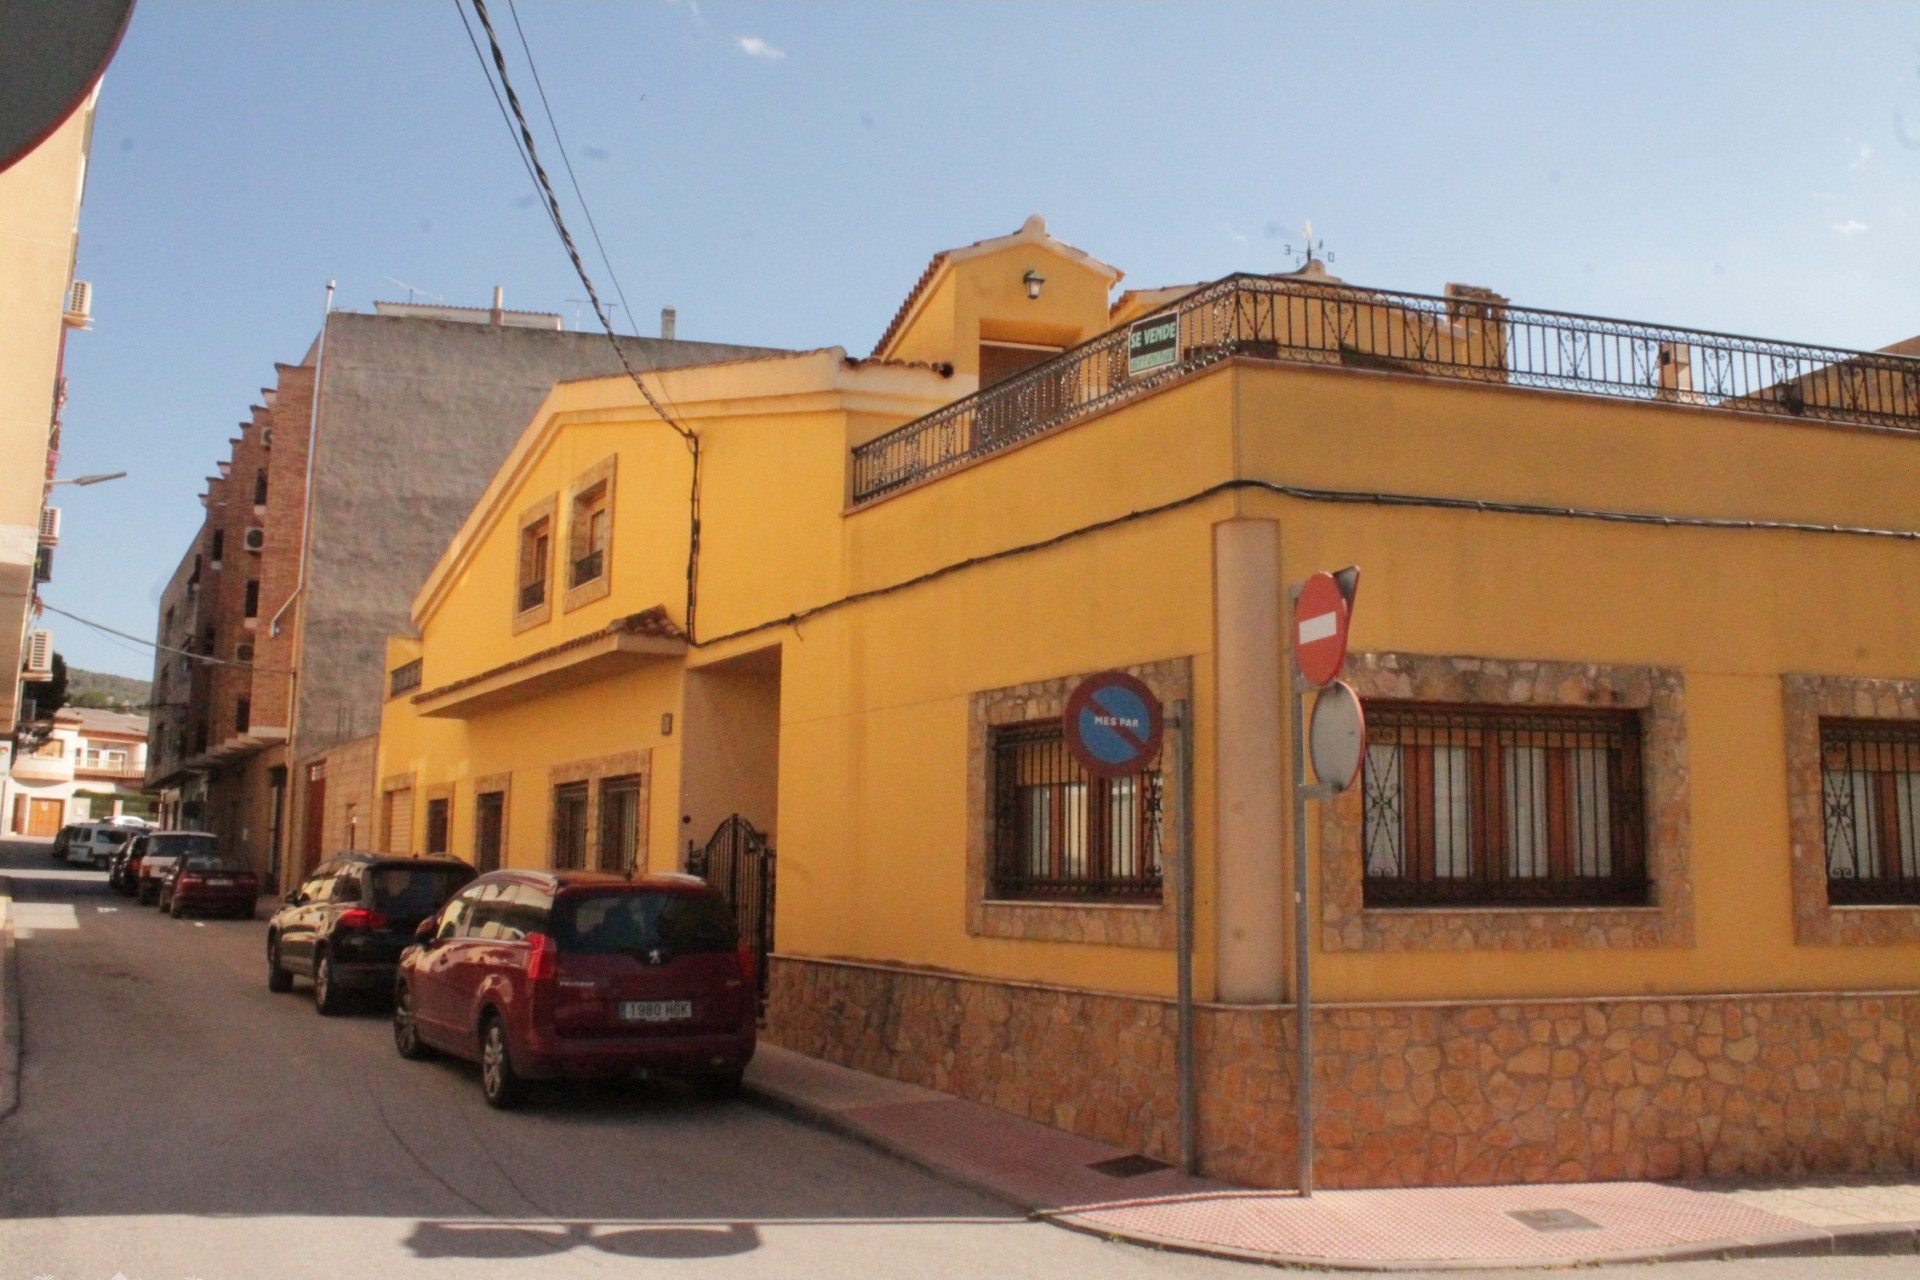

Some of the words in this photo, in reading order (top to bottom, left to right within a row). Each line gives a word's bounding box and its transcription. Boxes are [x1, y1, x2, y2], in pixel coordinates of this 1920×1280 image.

[1130, 331, 1142, 349] SE
[1144, 322, 1176, 345] VENDE
[1095, 716, 1117, 726] MES
[1119, 717, 1139, 728] PAR
